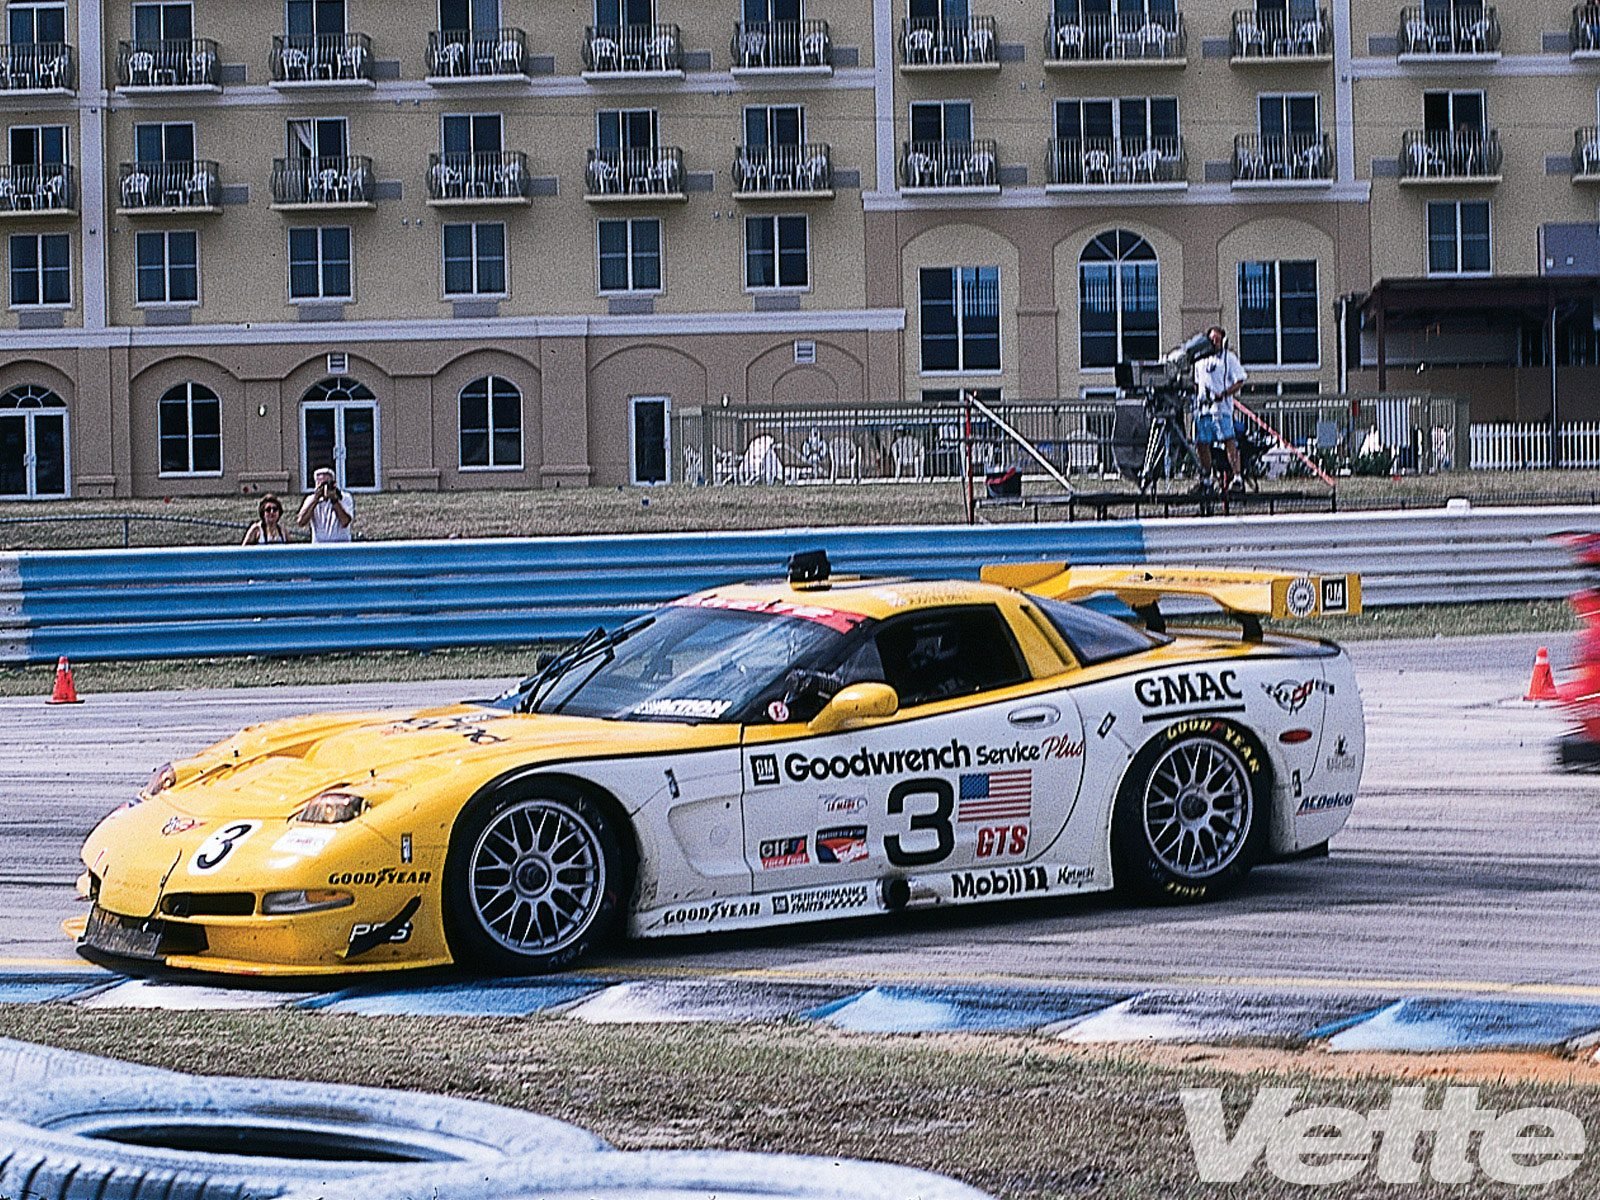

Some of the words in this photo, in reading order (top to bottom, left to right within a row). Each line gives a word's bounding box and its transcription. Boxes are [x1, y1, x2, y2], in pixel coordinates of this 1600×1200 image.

[1134, 670, 1243, 708] GMAC
[784, 739, 971, 782] Goodwrench
[1041, 733, 1083, 761] Plus
[883, 778, 955, 867] 3
[976, 824, 1028, 859] GTS
[197, 824, 252, 869] 3
[951, 868, 1022, 899] Mobil
